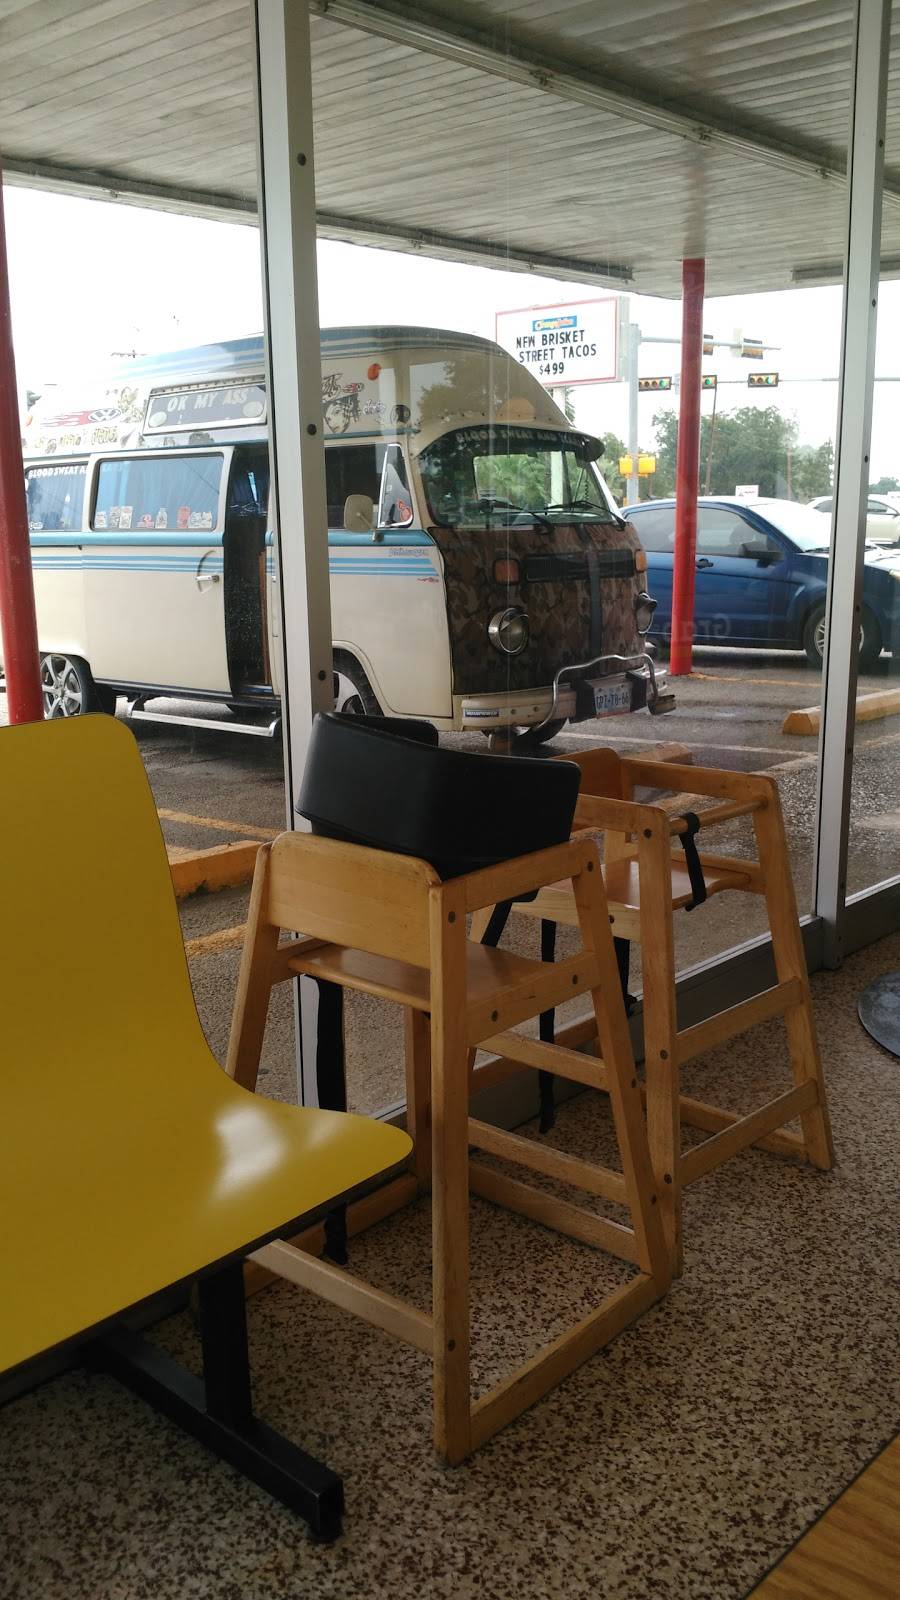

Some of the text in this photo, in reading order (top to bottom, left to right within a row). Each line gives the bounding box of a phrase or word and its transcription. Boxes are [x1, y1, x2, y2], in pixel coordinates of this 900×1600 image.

[541, 330, 585, 346] BRISKET
[519, 344, 597, 363] STREET TACOS
[194, 393, 218, 409] MY
